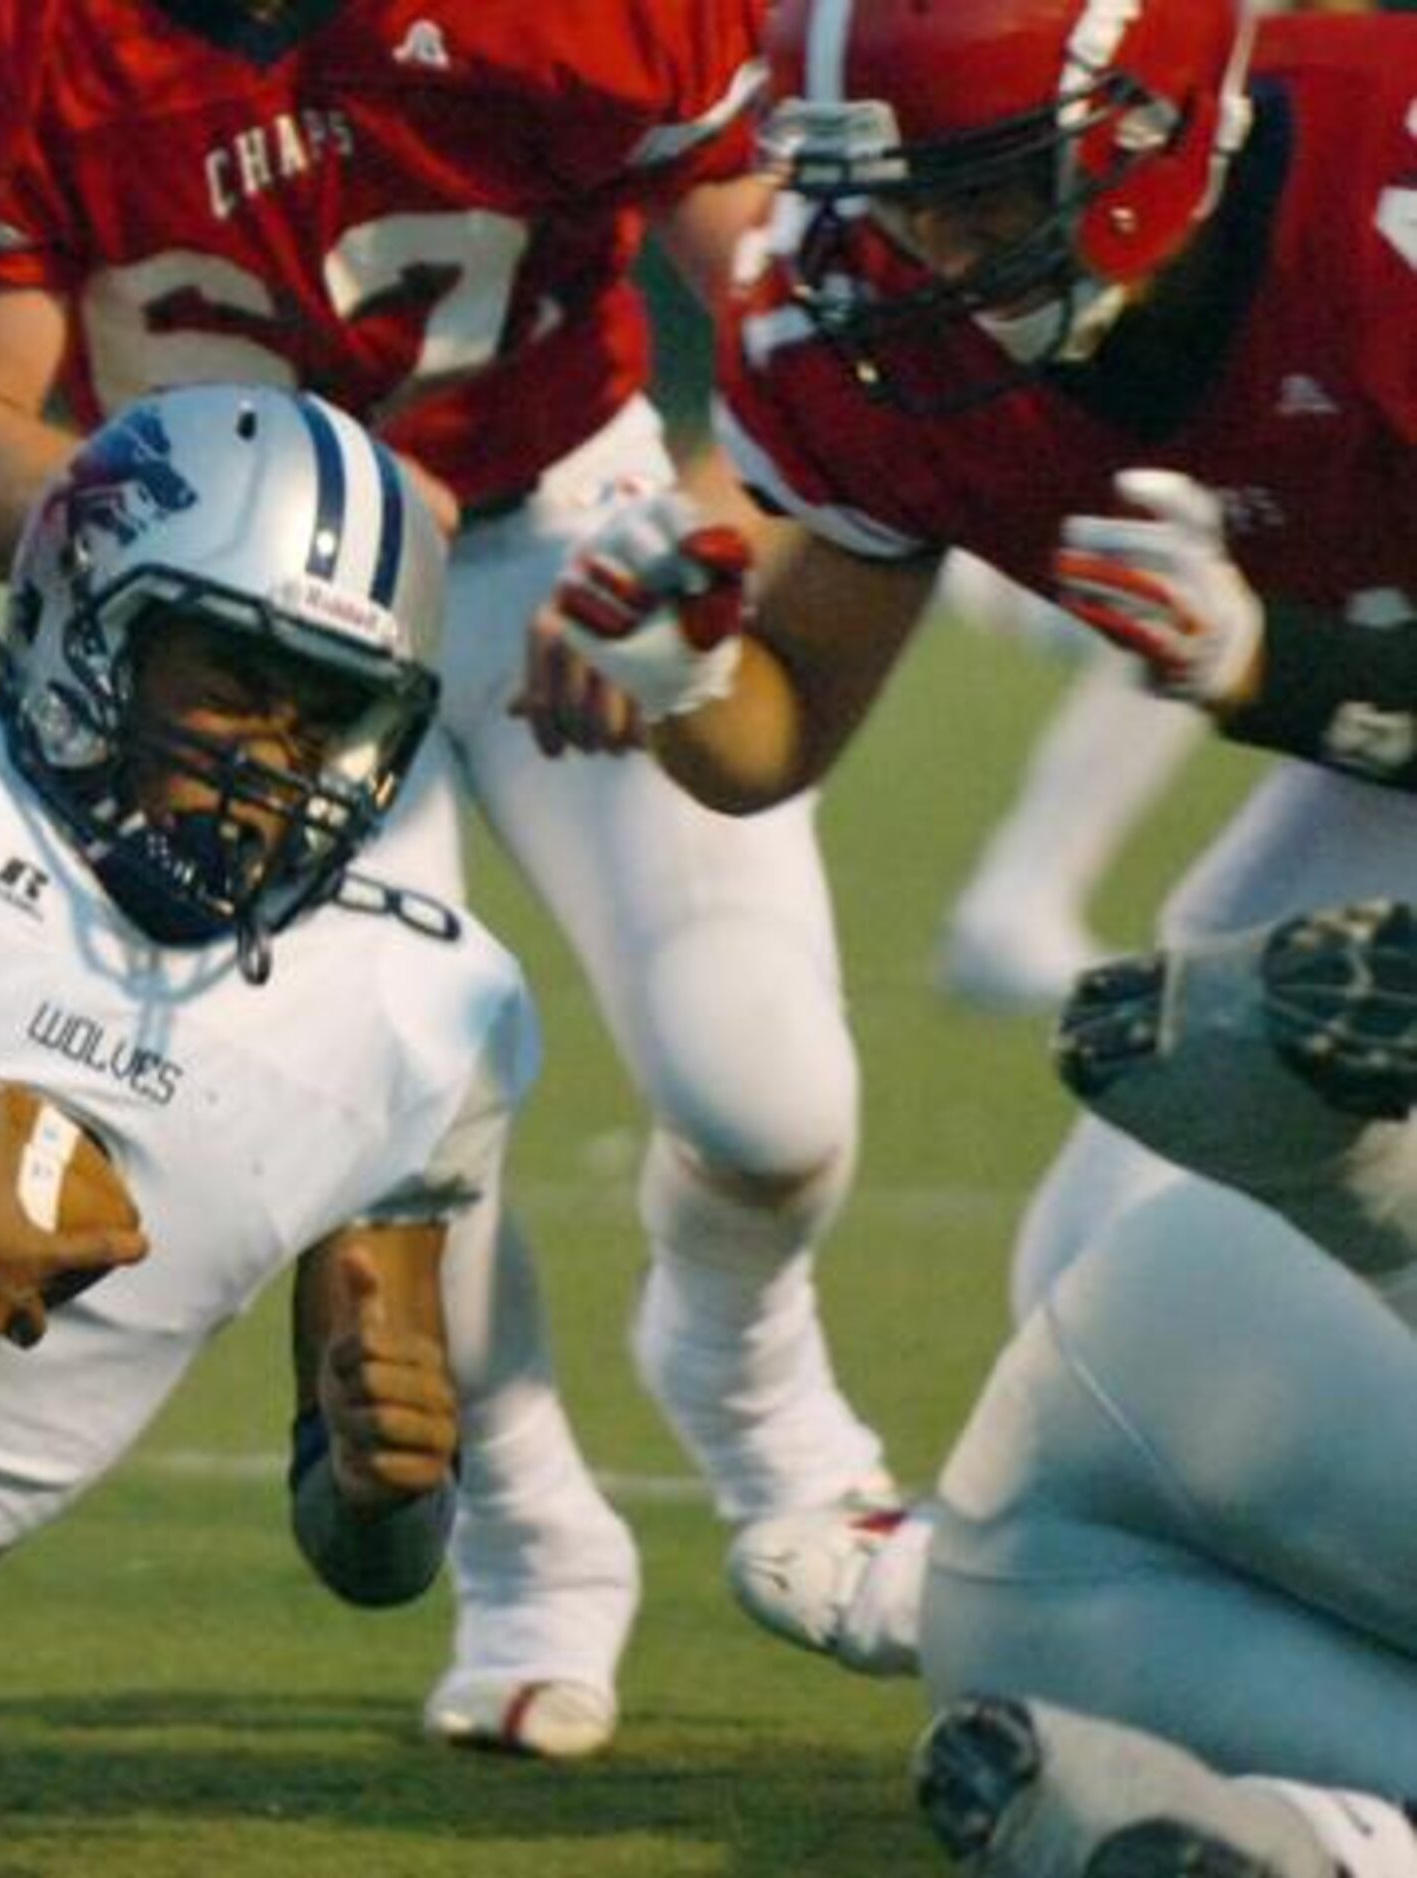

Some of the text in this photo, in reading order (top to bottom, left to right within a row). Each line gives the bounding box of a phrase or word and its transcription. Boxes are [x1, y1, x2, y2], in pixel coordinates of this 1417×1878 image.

[205, 109, 353, 219] CHAPS
[333, 872, 461, 943] 8
[28, 1001, 184, 1104] WOLVES
